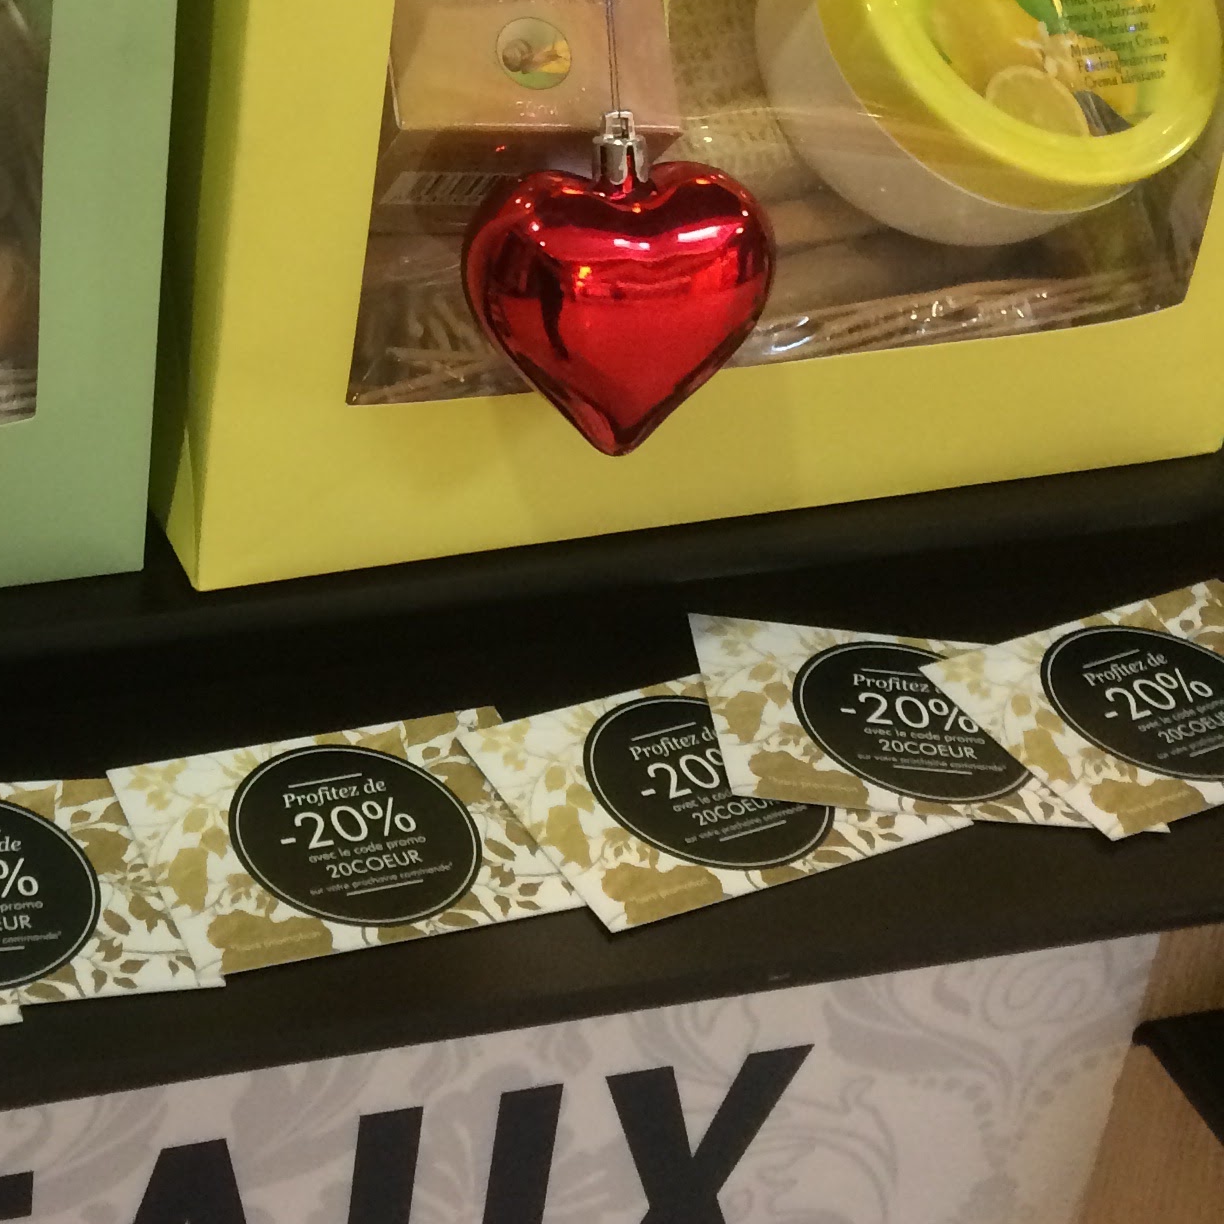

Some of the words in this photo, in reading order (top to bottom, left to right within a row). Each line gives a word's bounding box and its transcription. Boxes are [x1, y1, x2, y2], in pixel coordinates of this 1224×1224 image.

[853, 674, 929, 694] Profitez
[1082, 661, 1147, 687] Profitez
[1147, 652, 1168, 668] de
[1104, 668, 1214, 721] -20%
[840, 692, 979, 734] -20%
[629, 733, 700, 762] Profitez
[878, 739, 978, 760] 20COEUR
[283, 786, 360, 809] Profitez
[364, 778, 387, 794] de
[280, 796, 417, 850] -20%
[326, 849, 423, 879] 20COEUR
[0, 901, 44, 913] promo
